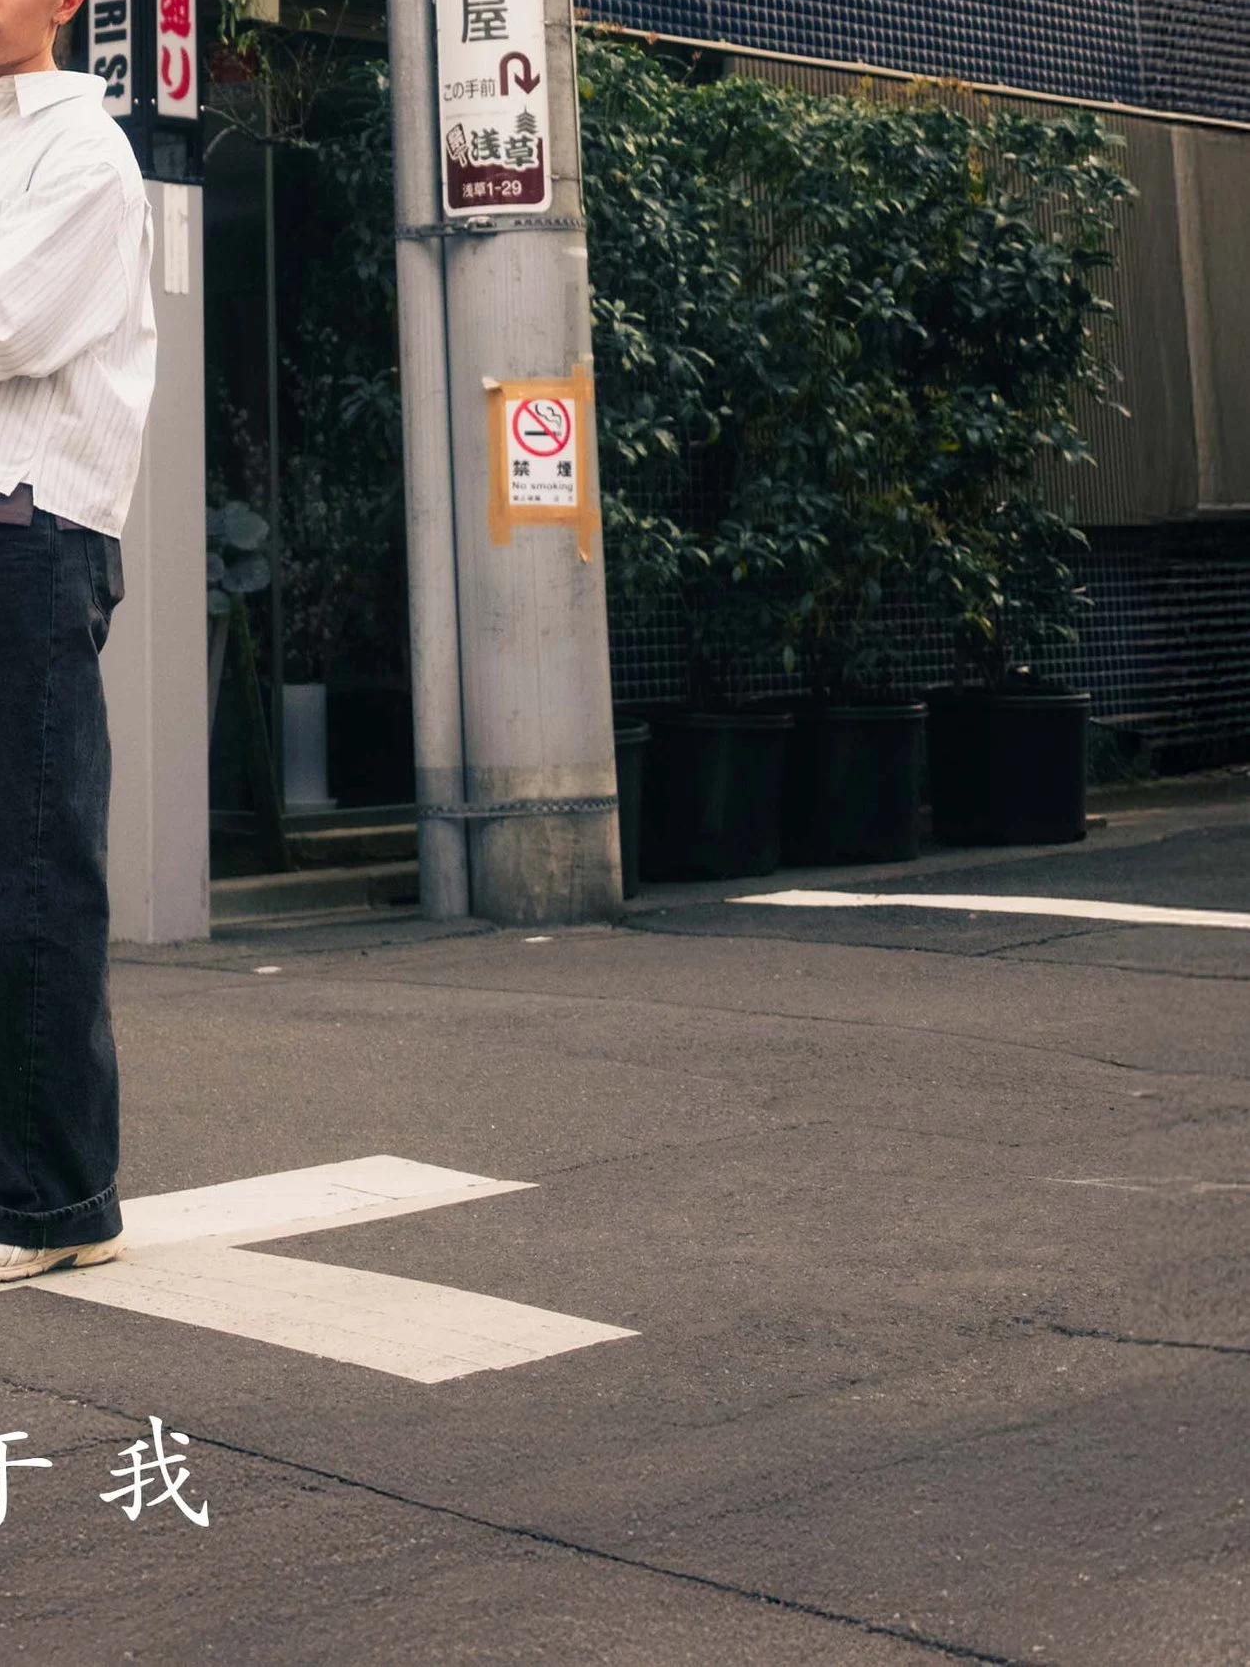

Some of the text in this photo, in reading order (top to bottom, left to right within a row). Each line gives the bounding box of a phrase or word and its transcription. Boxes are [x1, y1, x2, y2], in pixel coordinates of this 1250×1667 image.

[94, 53, 129, 101] St
[443, 78, 496, 102] この手前
[470, 128, 535, 167] 浅草
[462, 180, 523, 198] 浅草1-29
[512, 459, 573, 477] 禁煙
[512, 481, 574, 494] No smoking
